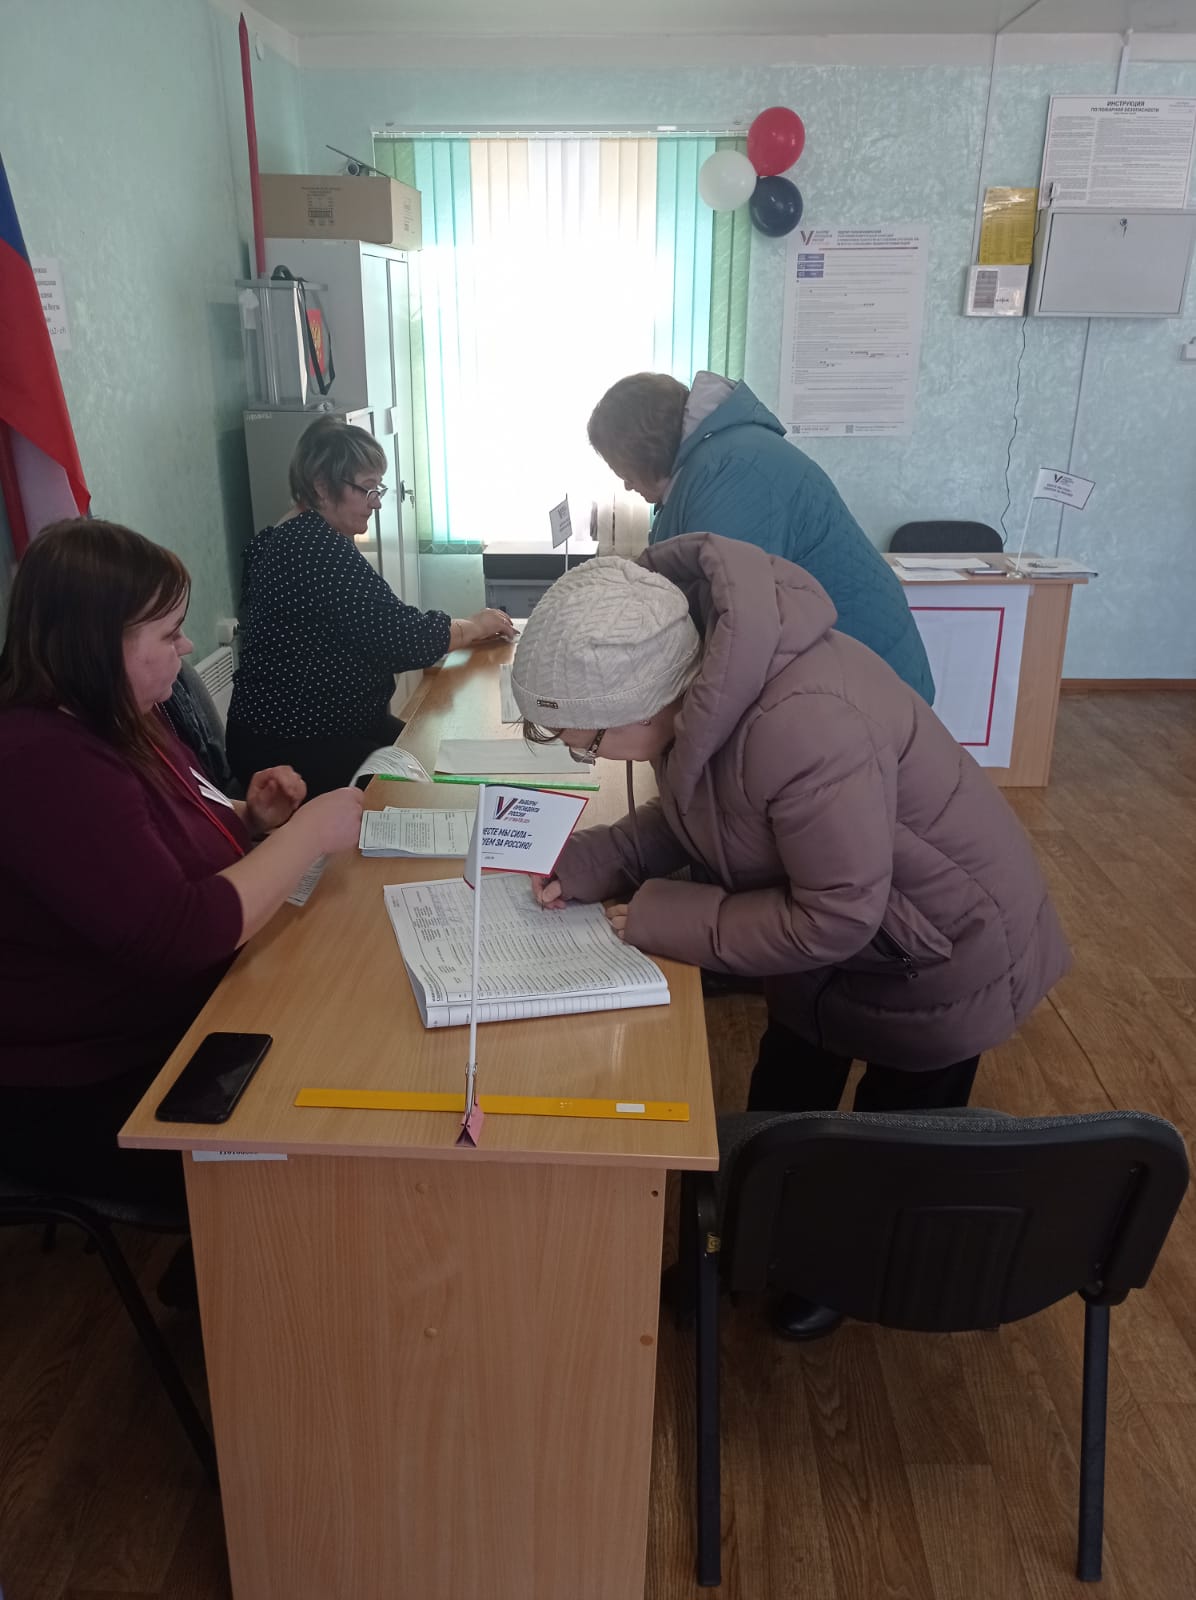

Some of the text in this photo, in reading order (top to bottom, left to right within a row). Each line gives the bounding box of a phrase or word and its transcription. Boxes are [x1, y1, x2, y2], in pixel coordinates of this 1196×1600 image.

[498, 828, 511, 837] МЫ
[510, 829, 527, 839] СИЛА
[495, 838, 504, 847] ЗА
[504, 840, 532, 850] РОССИЮ!
